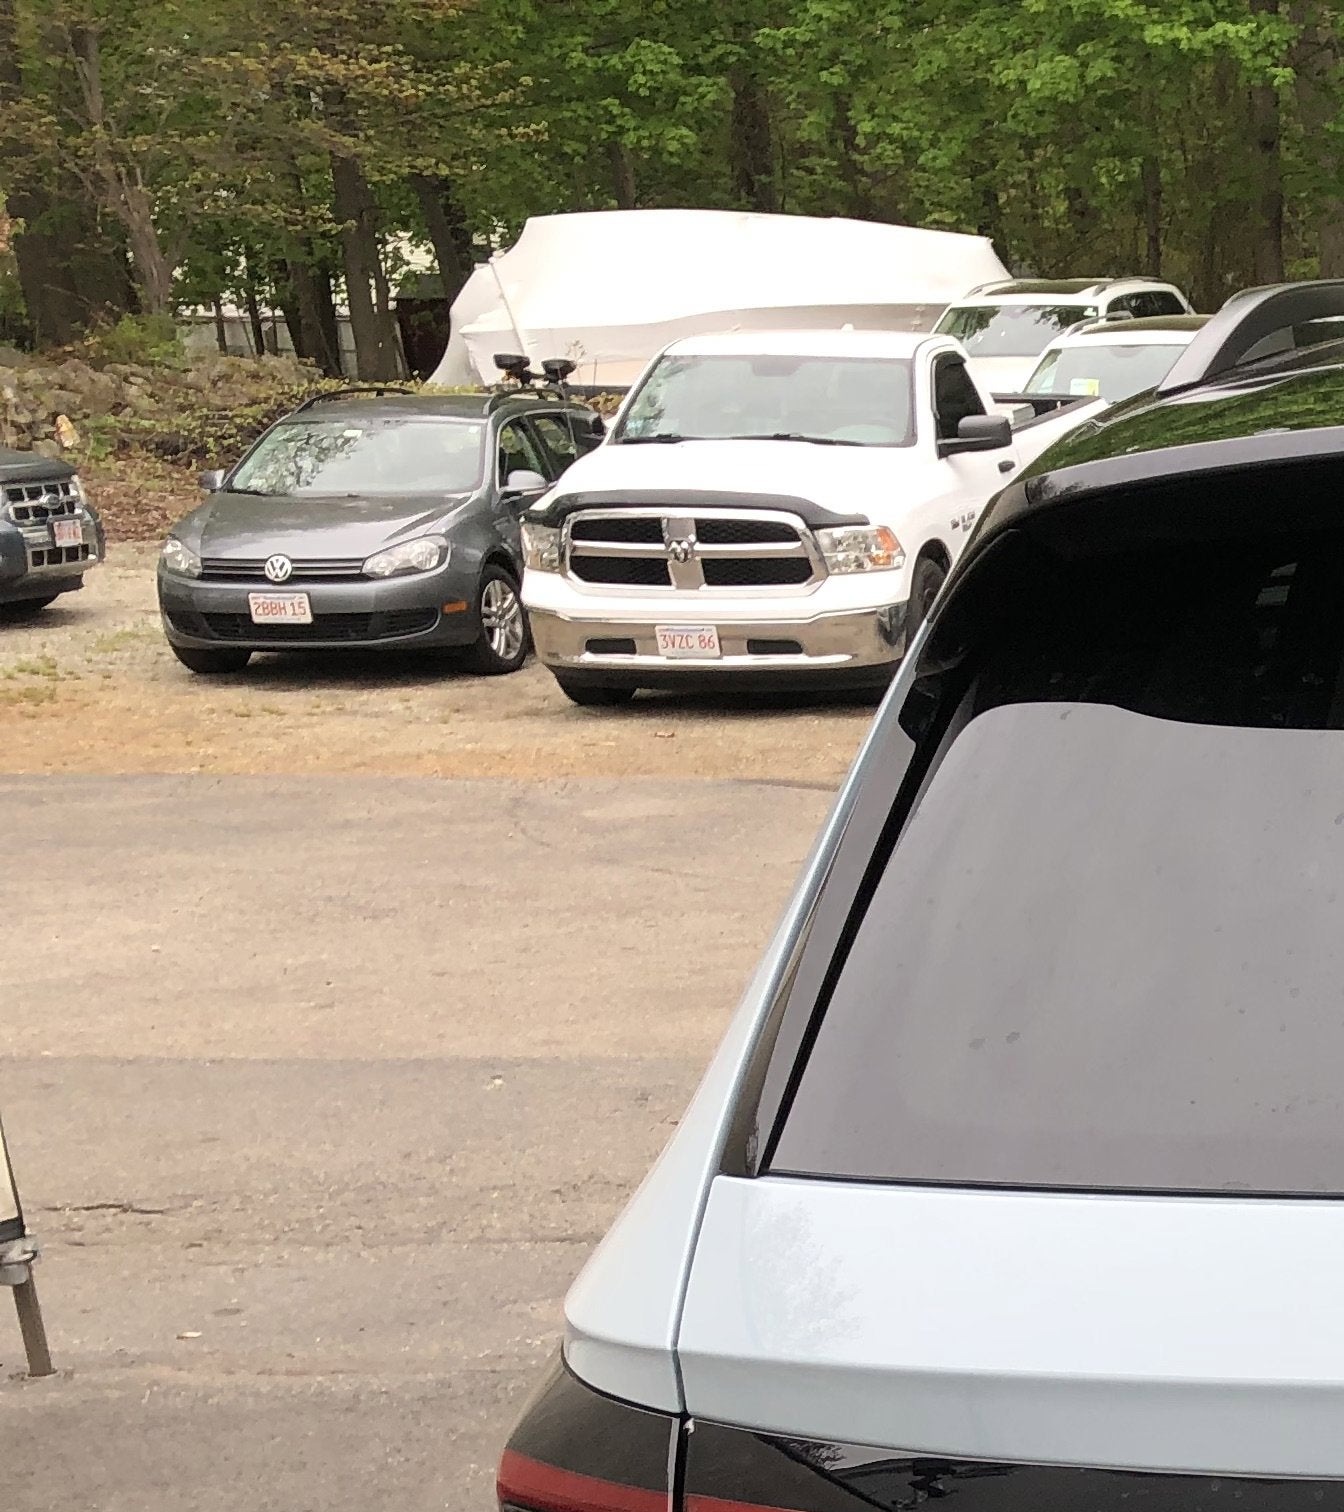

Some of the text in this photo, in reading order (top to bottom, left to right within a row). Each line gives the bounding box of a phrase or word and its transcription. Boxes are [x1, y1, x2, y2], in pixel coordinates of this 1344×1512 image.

[253, 601, 306, 616] 2BBH 15
[660, 634, 716, 650] 3VZC 86
